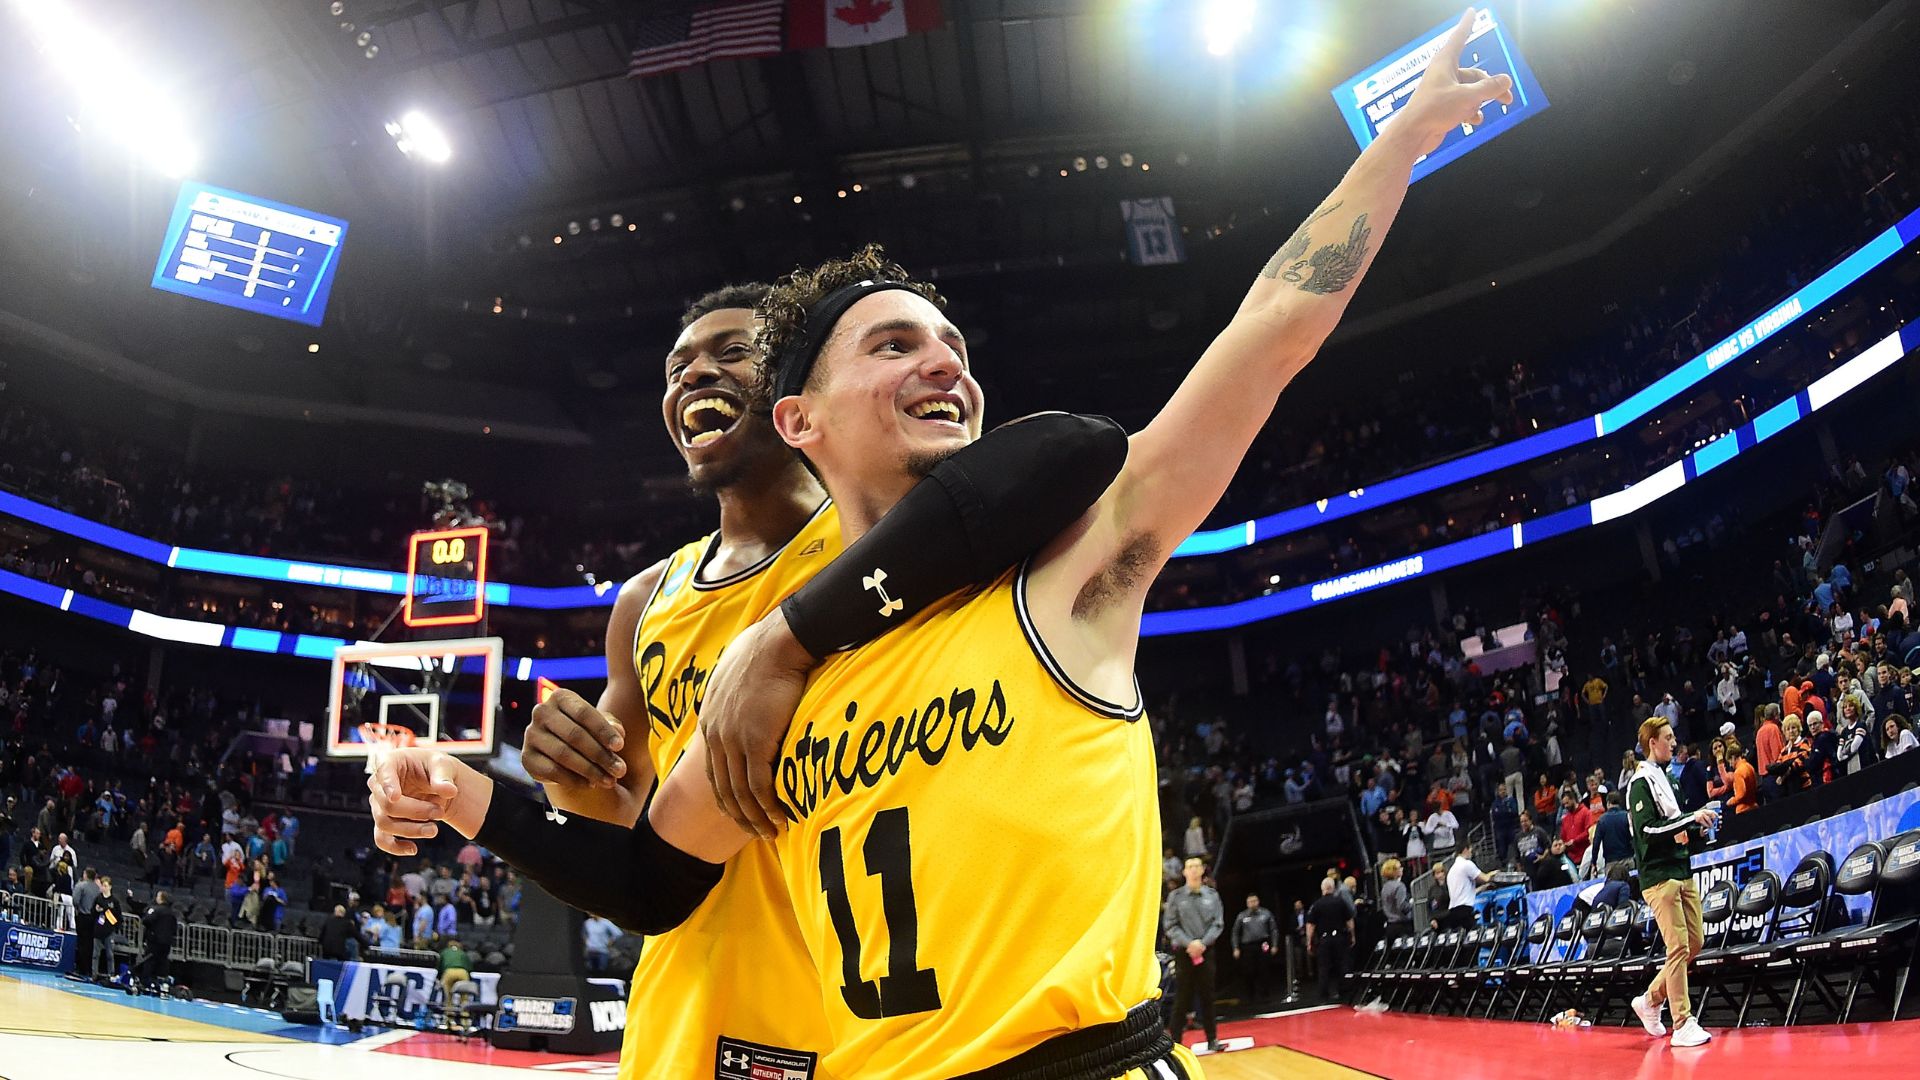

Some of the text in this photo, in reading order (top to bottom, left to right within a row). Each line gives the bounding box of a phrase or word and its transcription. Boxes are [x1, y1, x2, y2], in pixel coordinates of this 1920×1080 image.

[1738, 328, 1755, 350] VS
[432, 538, 465, 564] 0.0
[774, 679, 1015, 831] etrievers
[819, 806, 942, 1019] 11
[18, 932, 49, 949] MARCH
[20, 945, 61, 962] MADNESS
[754, 1055, 807, 1067] UNDER ARMOUR
[752, 1068, 783, 1080] AUTHENTIC
